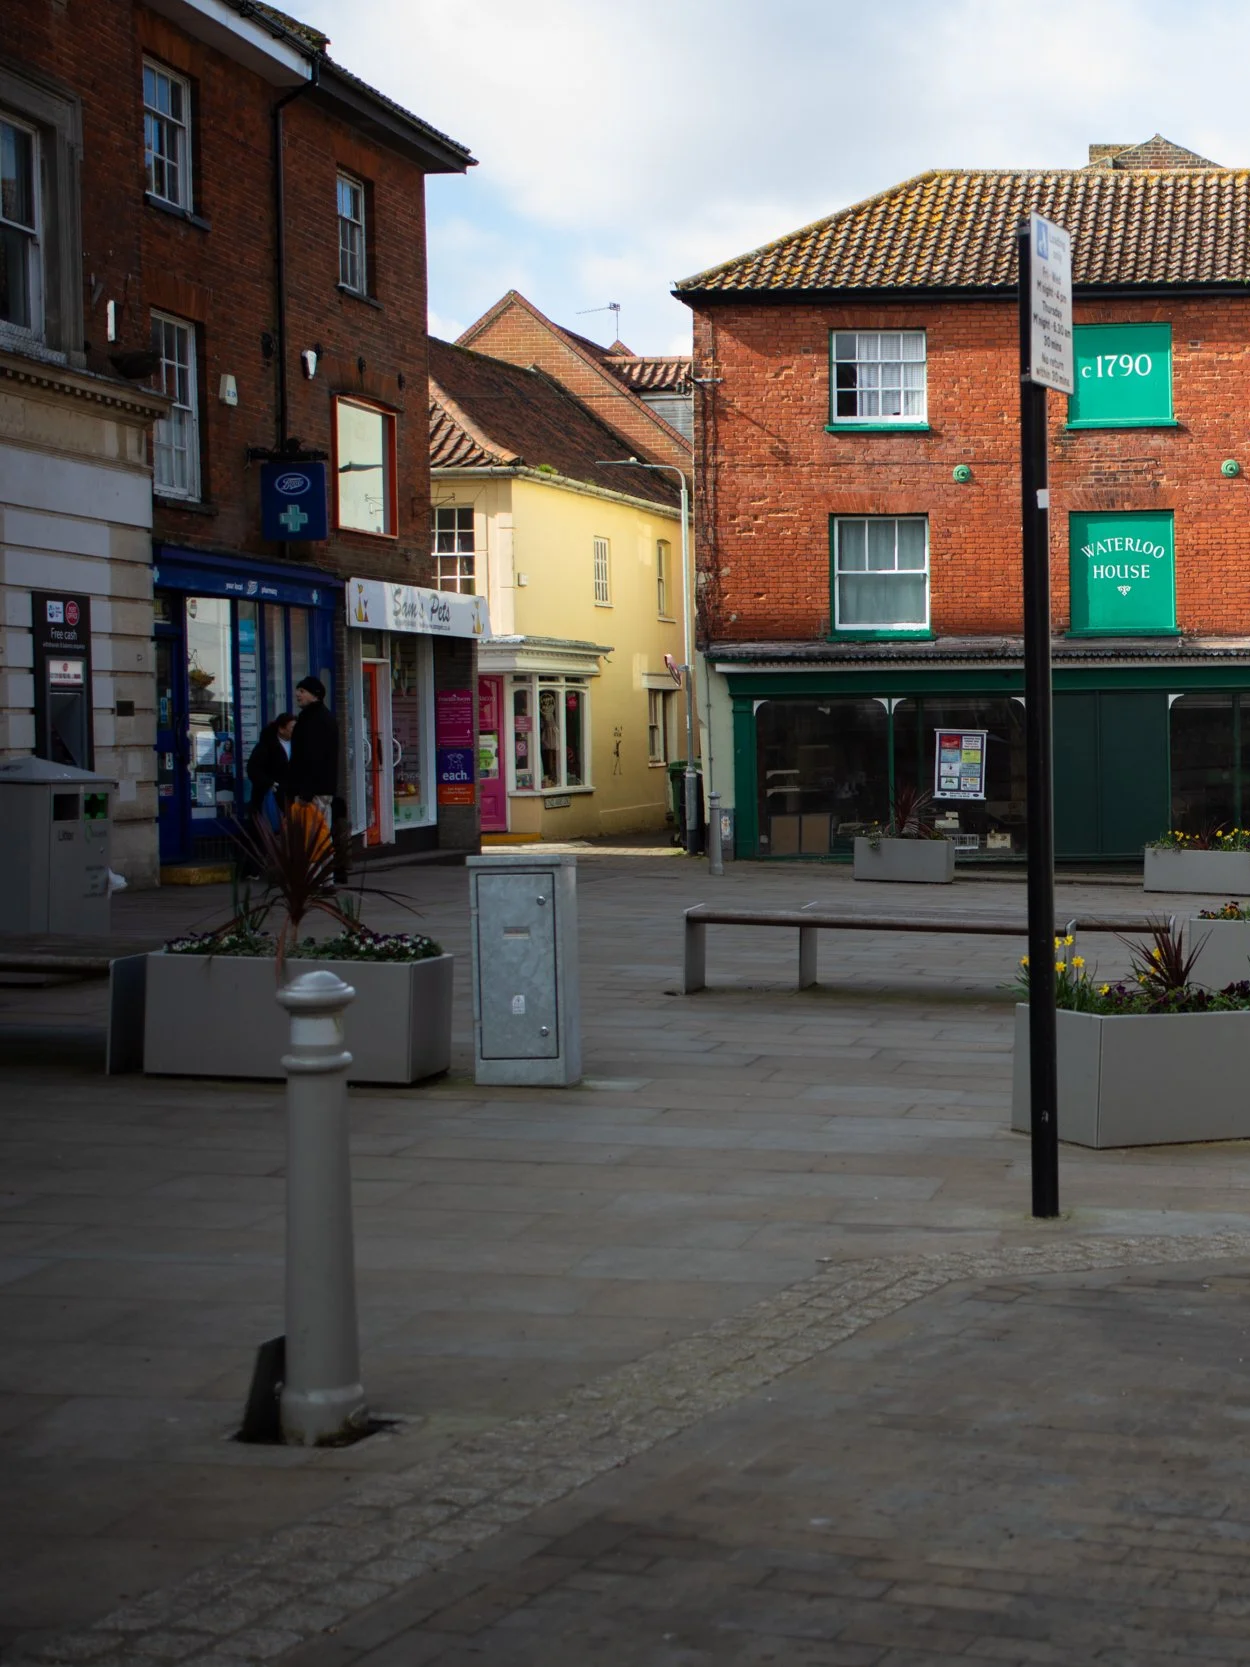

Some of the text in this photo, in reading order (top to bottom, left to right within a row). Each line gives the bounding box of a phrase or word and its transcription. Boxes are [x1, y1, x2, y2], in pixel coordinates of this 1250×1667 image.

[1042, 300, 1062, 321] Thursday
[1080, 537, 1165, 559] WATERLOO
[1092, 564, 1151, 579] HOUSE
[392, 588, 451, 622] Sam's Pets
[50, 627, 77, 640] Free cash
